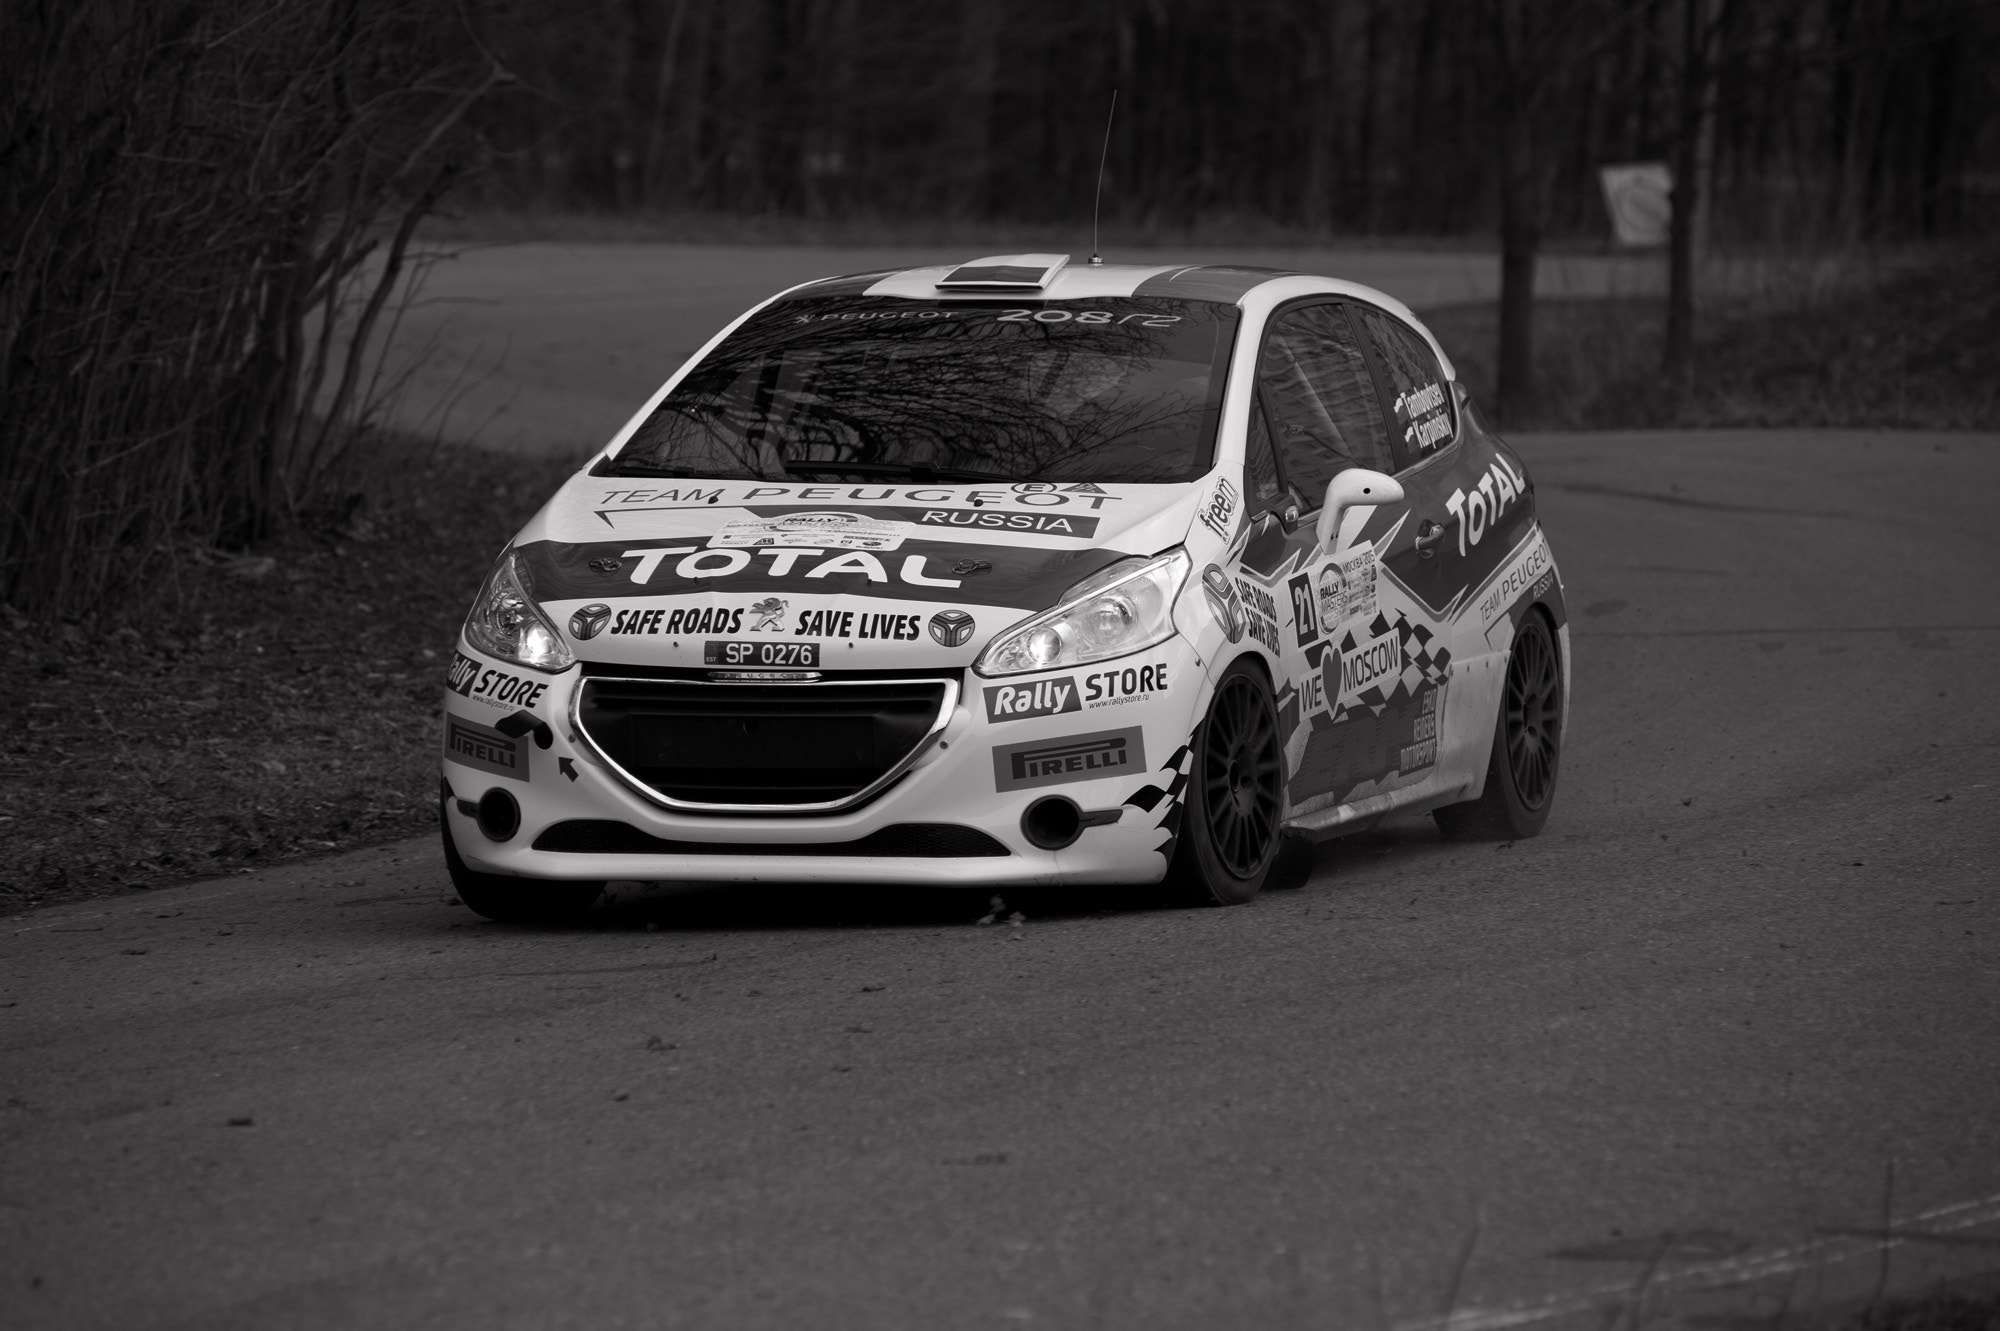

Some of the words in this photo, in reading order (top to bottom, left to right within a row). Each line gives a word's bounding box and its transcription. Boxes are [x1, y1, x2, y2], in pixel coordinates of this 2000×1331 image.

[821, 311, 958, 321] PEUGEOT
[601, 488, 726, 504] TEAM
[742, 487, 1123, 509] PEUGEOT
[1445, 453, 1526, 557] TOTAL
[921, 510, 1074, 533] RUSSIA
[620, 546, 963, 588] TOTAL
[1235, 576, 1257, 609] SAFE
[1320, 581, 1339, 600] RALLY
[1320, 590, 1348, 612] MASTERS
[1480, 588, 1502, 624] TEAM
[611, 609, 666, 635] SAFE
[666, 607, 745, 635] ROADS
[795, 609, 853, 638] SAVE
[858, 613, 921, 641] LIVES
[1295, 583, 1316, 635] 21
[725, 643, 754, 664] SP
[761, 643, 812, 665] 0276
[449, 652, 476, 692] Rally
[474, 669, 549, 709] STORE
[993, 680, 1072, 716] Rally
[1085, 662, 1168, 702] STORE
[1301, 674, 1322, 713] WE
[1343, 635, 1398, 693] MOSCOW
[1088, 693, 1150, 710] www.rallystore.ru
[449, 722, 517, 769] PIRELLI
[1011, 736, 1127, 780] PIRELLI
